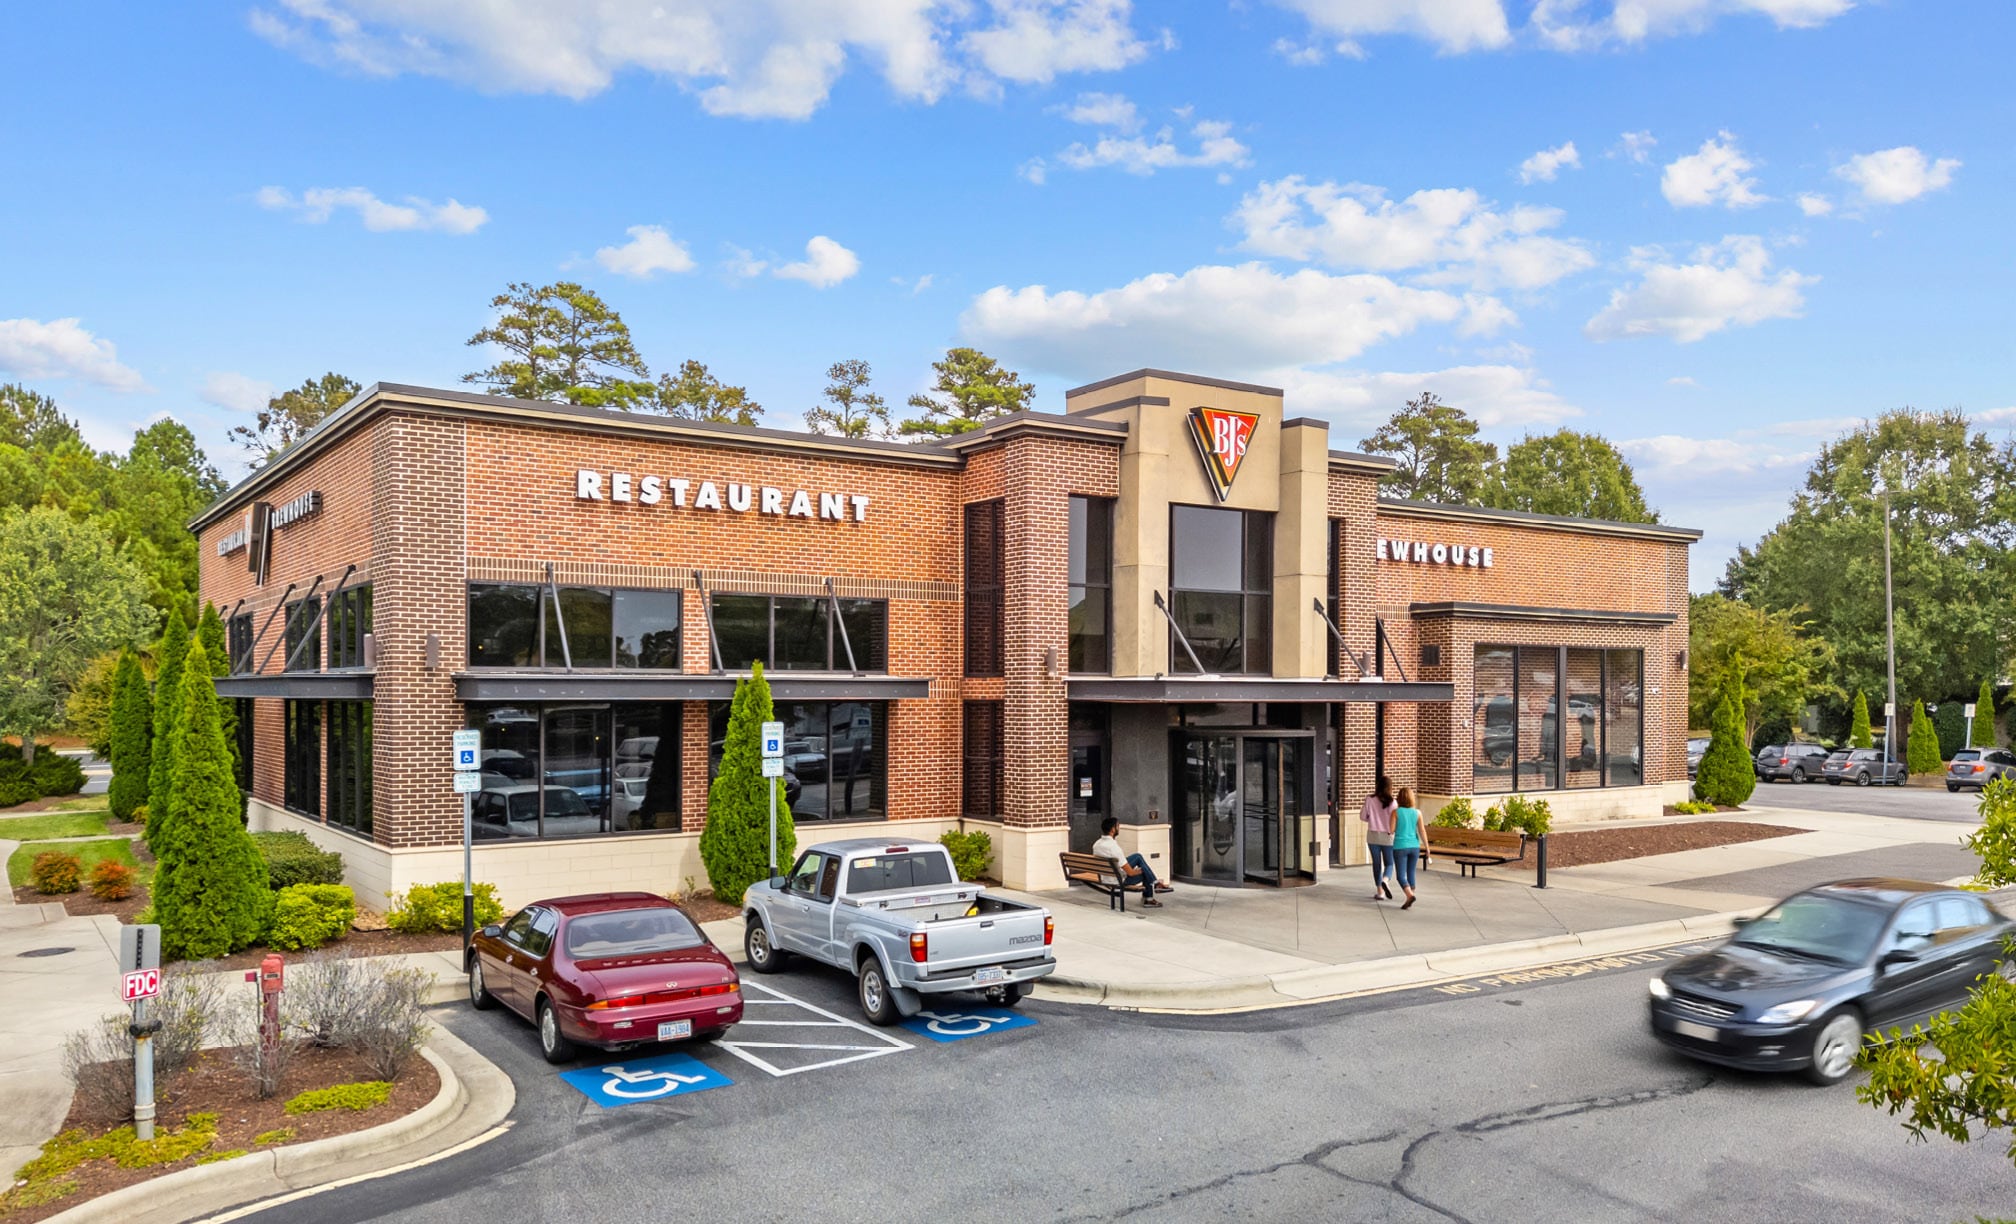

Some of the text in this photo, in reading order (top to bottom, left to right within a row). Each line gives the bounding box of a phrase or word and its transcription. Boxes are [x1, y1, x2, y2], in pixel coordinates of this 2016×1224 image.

[1213, 415, 1248, 467] BJ's
[577, 470, 869, 521] RESTAURANT
[1376, 540, 1493, 567] EWHOUSE
[126, 972, 157, 997] FDC
[1433, 983, 1481, 995] NO
